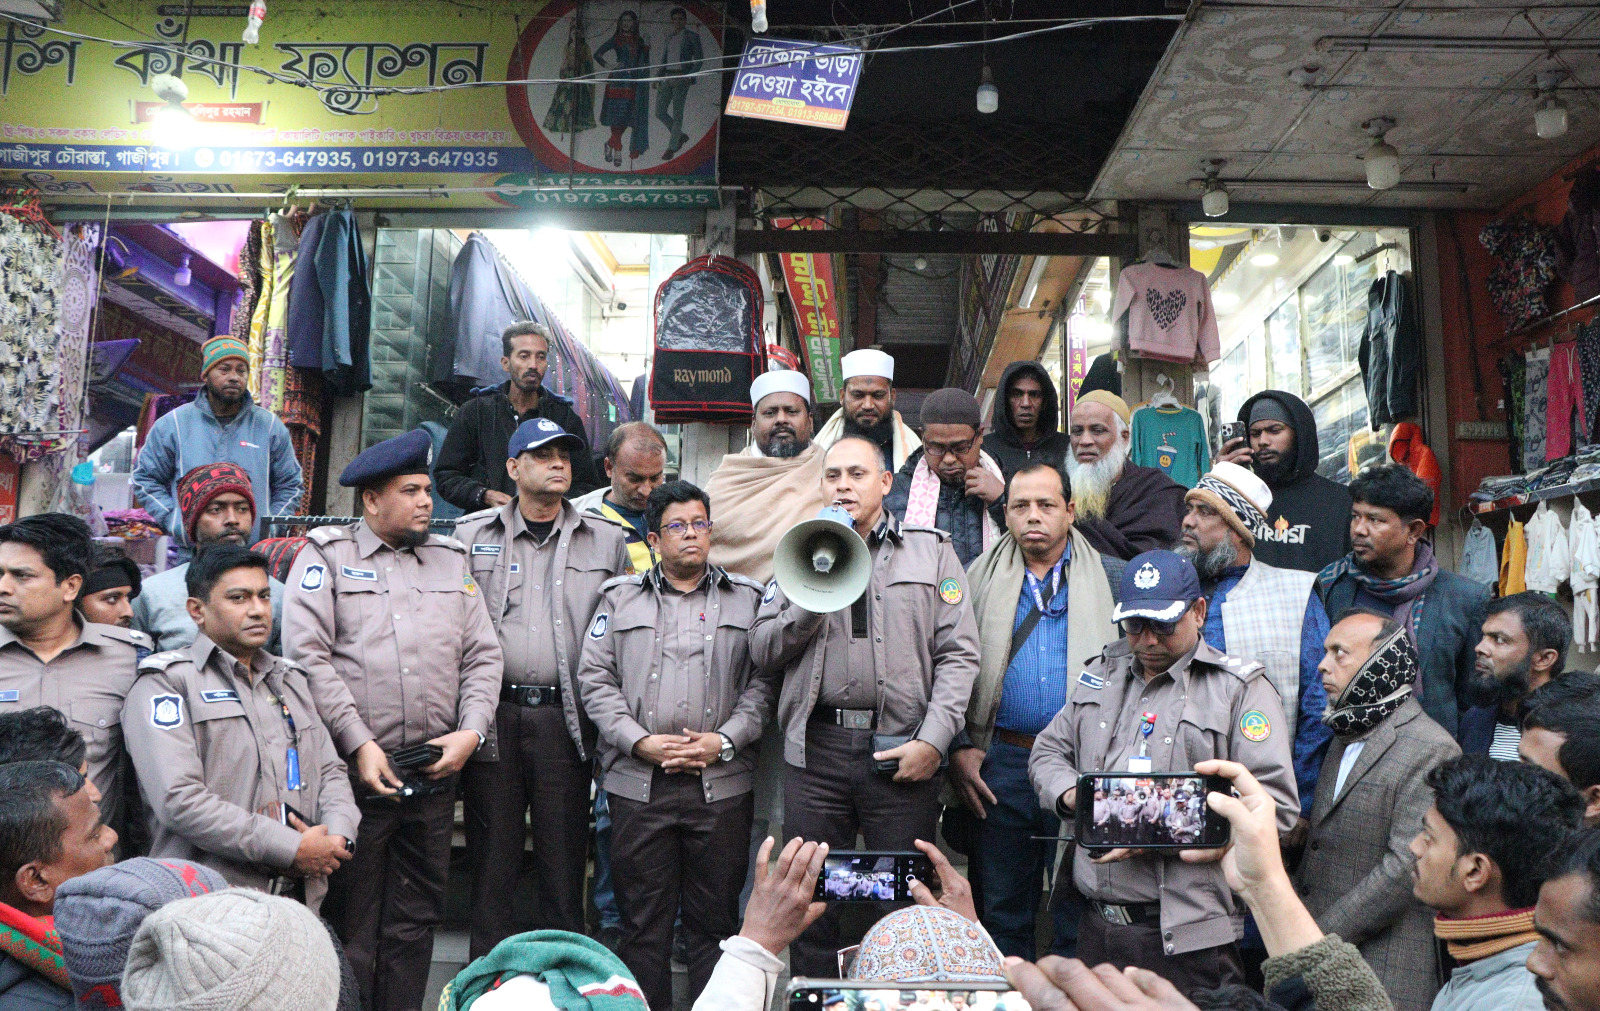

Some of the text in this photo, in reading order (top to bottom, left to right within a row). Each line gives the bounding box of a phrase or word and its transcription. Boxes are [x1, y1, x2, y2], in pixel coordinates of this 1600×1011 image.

[112, 17, 245, 101] কাঁথা
[274, 42, 489, 115] ফ্যাশন
[748, 45, 859, 78] দোকান ভাড়া
[740, 73, 851, 104] দেওয়া হইবে
[222, 107, 252, 119] রহমান
[48, 128, 71, 138] সকল
[278, 127, 322, 143] কোয়ালিটি
[323, 129, 357, 142] পোশাক
[359, 126, 396, 143] পাইকারি
[398, 130, 408, 141] ও
[409, 130, 433, 144] খুচরা
[56, 146, 111, 168] চৌরাস্তা,
[220, 150, 499, 170] 01673-647935, 01973-647935
[533, 192, 710, 204] 01973-647935
[674, 367, 732, 387] Raymond
